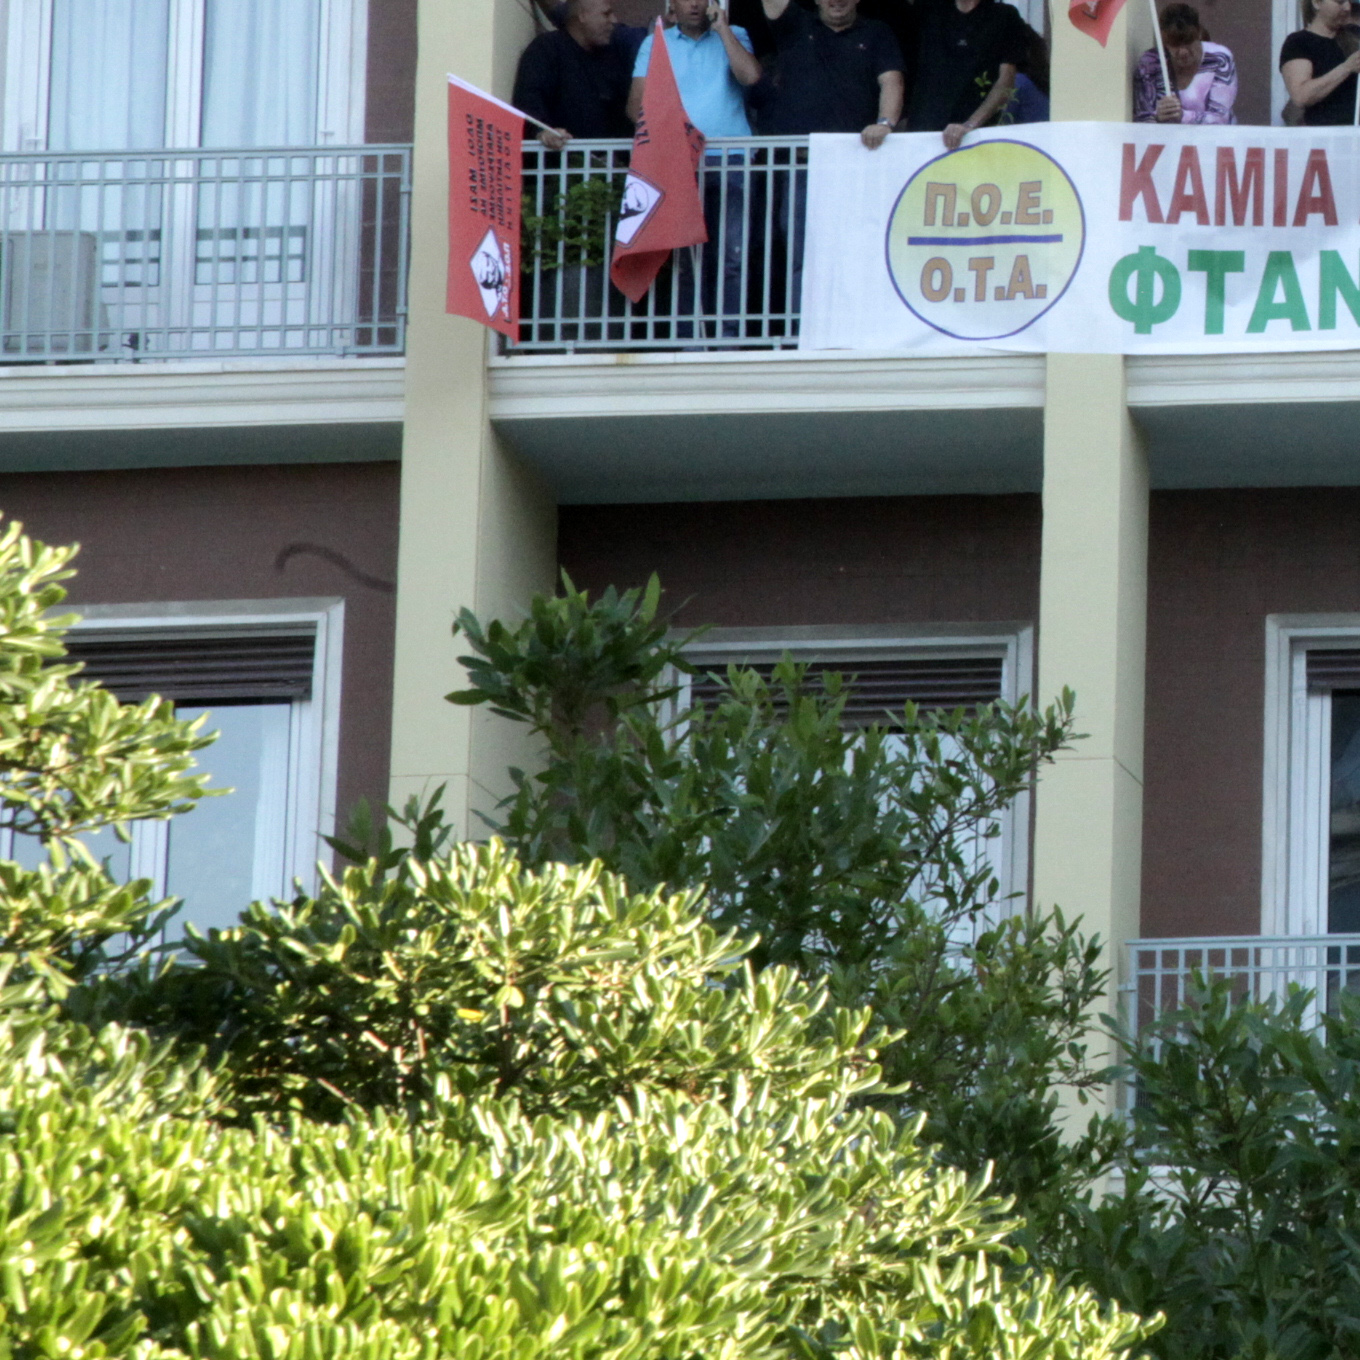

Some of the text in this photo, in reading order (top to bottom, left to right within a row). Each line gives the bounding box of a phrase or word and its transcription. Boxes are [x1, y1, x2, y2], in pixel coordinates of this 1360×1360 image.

[923, 180, 1054, 227] Π.Ο.Ε.
[1118, 142, 1339, 228] ΚΑΜΙΑ
[919, 254, 1048, 303] Ο.Τ.Α.
